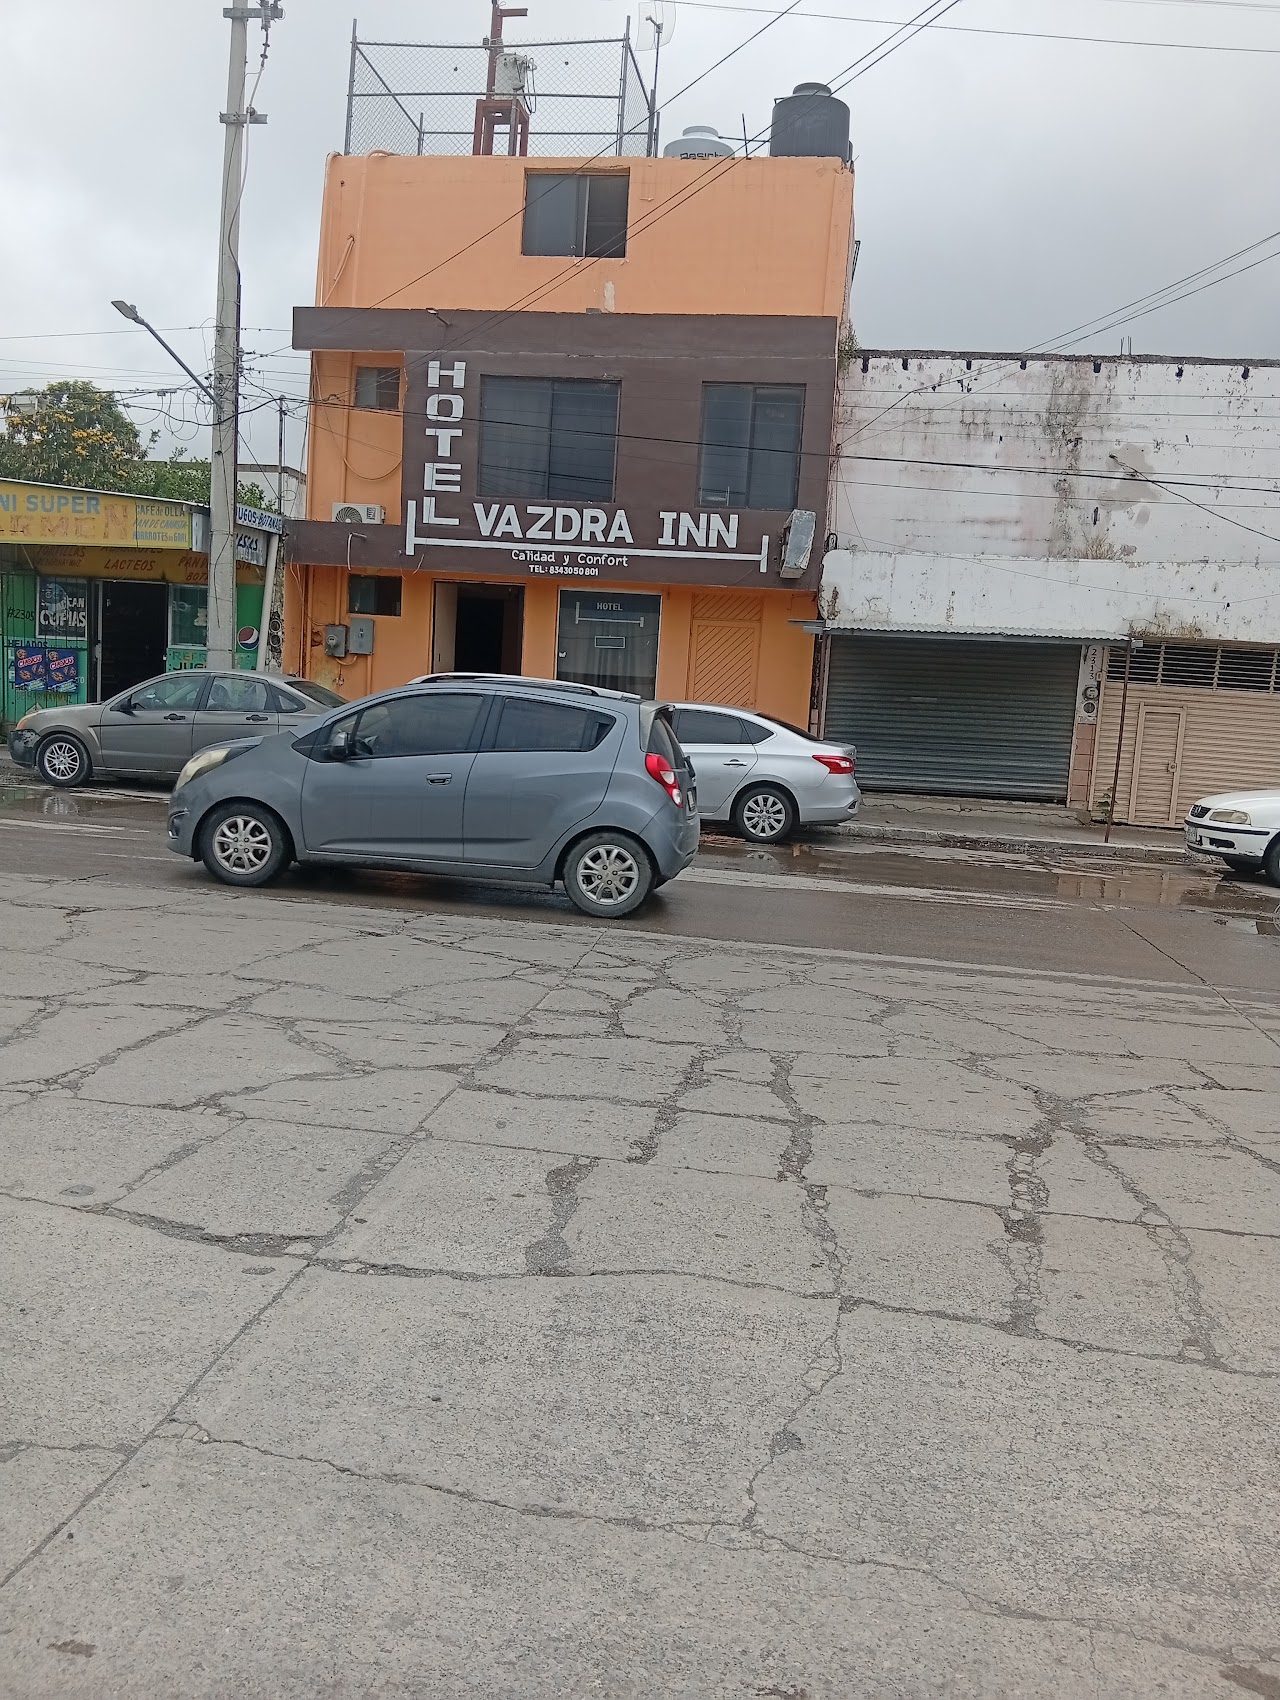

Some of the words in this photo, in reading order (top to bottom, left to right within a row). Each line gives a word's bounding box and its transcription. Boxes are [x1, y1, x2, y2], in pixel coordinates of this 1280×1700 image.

[423, 360, 466, 526] HOTEL
[26, 494, 101, 514] SUPER
[164, 505, 186, 517] OLLA
[473, 503, 634, 545] VAZDRA
[657, 511, 739, 549] INN
[104, 558, 155, 571] LACTEOS
[511, 549, 556, 562] Calidad
[562, 553, 570, 565] y
[577, 553, 629, 567] Confort
[597, 602, 623, 611] HOTEL
